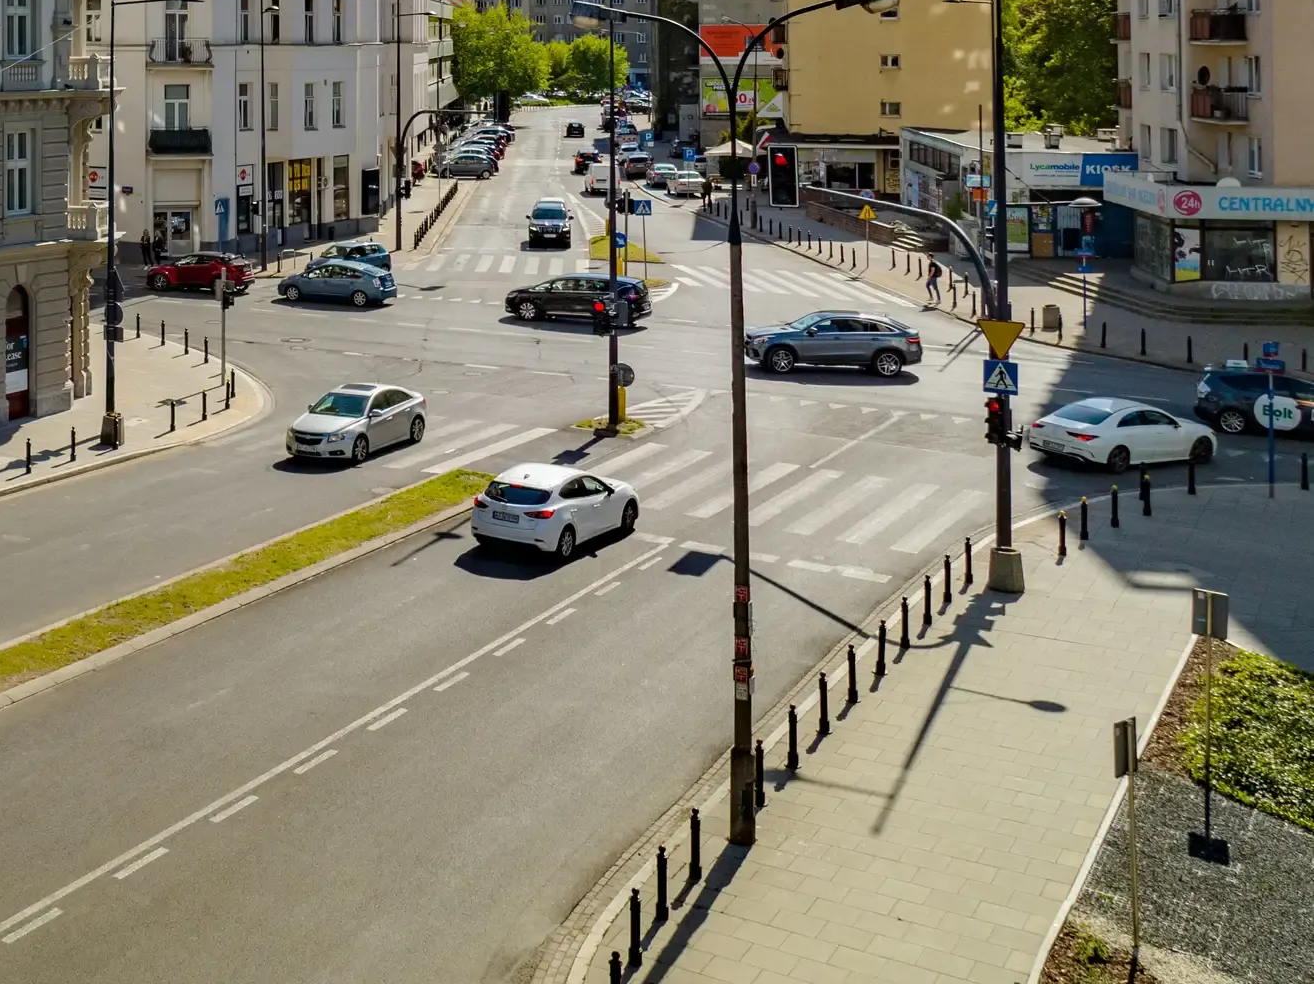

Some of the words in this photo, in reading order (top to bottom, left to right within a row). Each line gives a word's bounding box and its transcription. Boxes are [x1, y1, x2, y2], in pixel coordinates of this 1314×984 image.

[1029, 162, 1080, 171] Lycamobile
[1086, 164, 1132, 174] KIOSK
[1181, 197, 1200, 209] 24h
[1218, 196, 1314, 212] CENTRALNY
[5, 351, 22, 361] ease
[1262, 404, 1294, 421] Bolt
